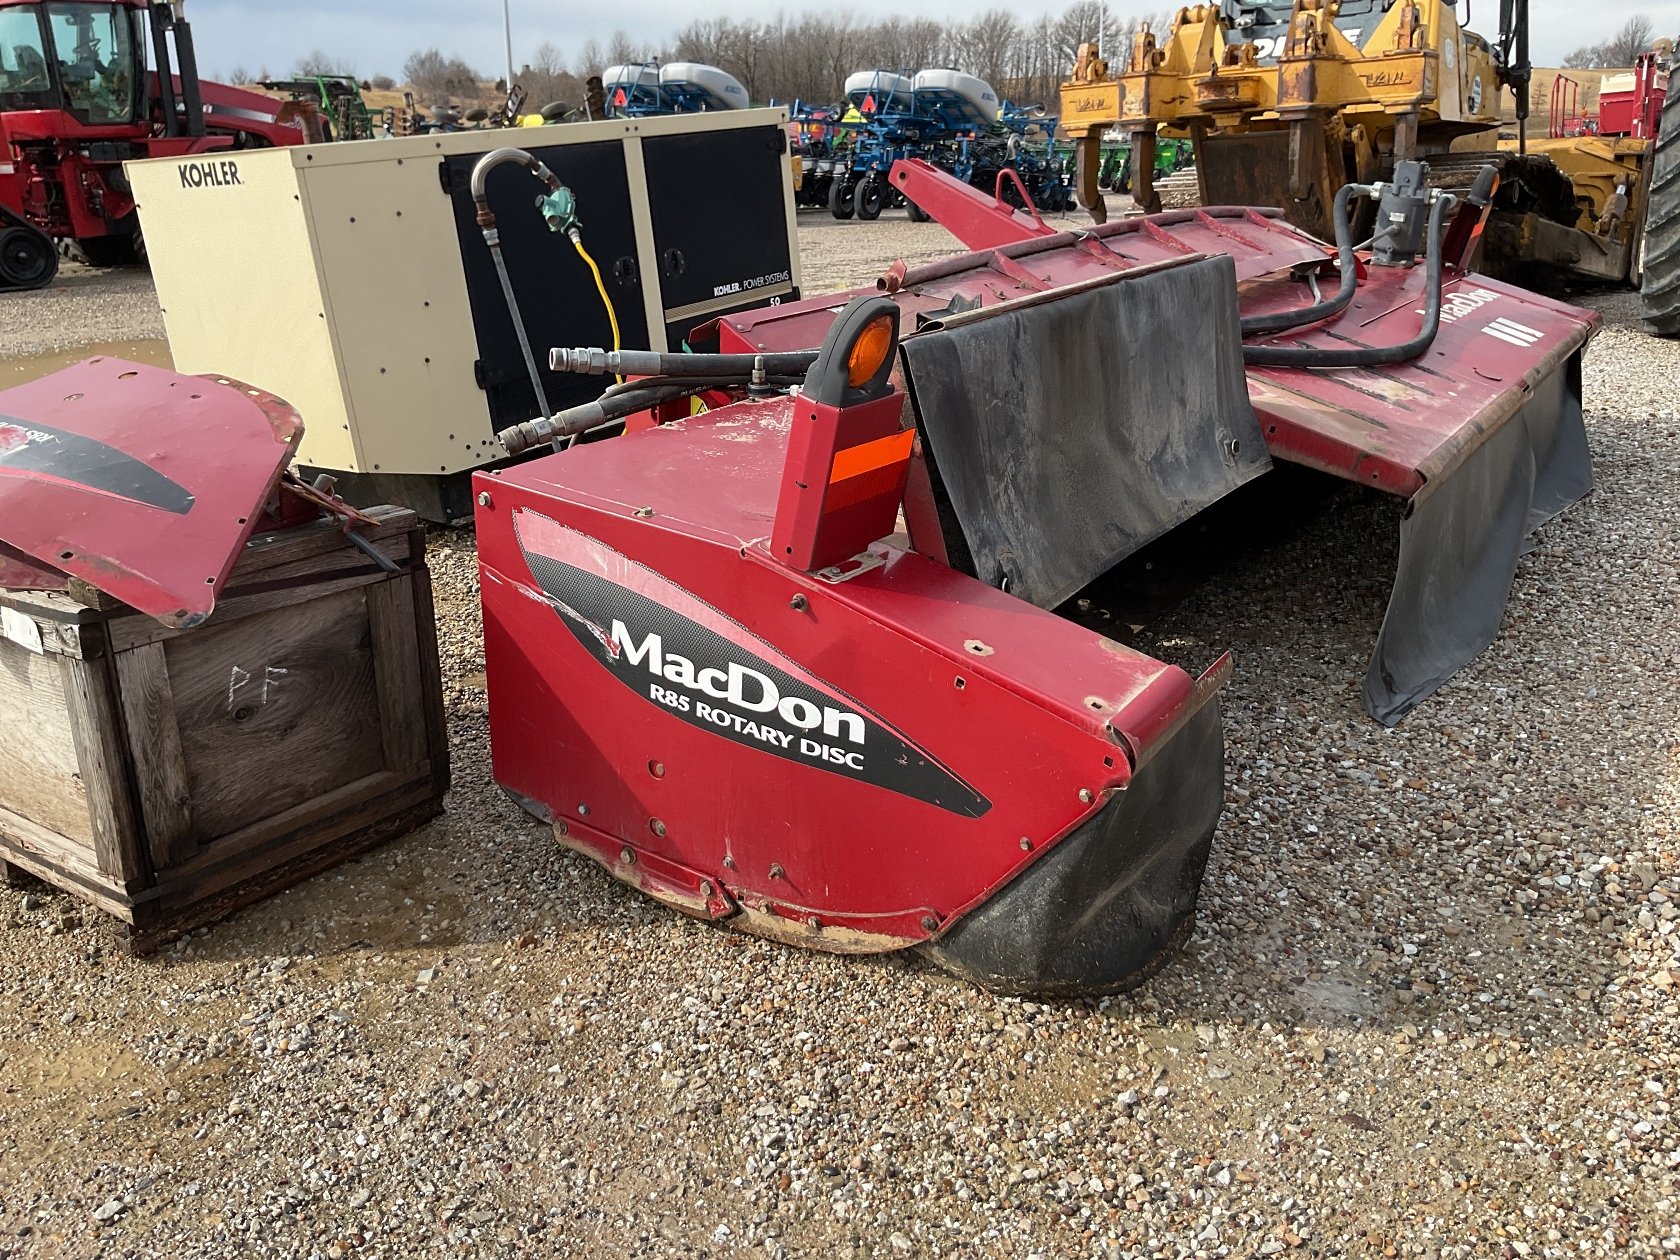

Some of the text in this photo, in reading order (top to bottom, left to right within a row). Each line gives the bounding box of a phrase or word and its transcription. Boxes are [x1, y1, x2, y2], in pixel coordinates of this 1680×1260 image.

[178, 161, 241, 188] KOHLER
[713, 270, 789, 296] KOHLER POWER SYSTEMS
[611, 618, 866, 745] MacDon
[650, 683, 865, 770] R85 ROTARY DISC
